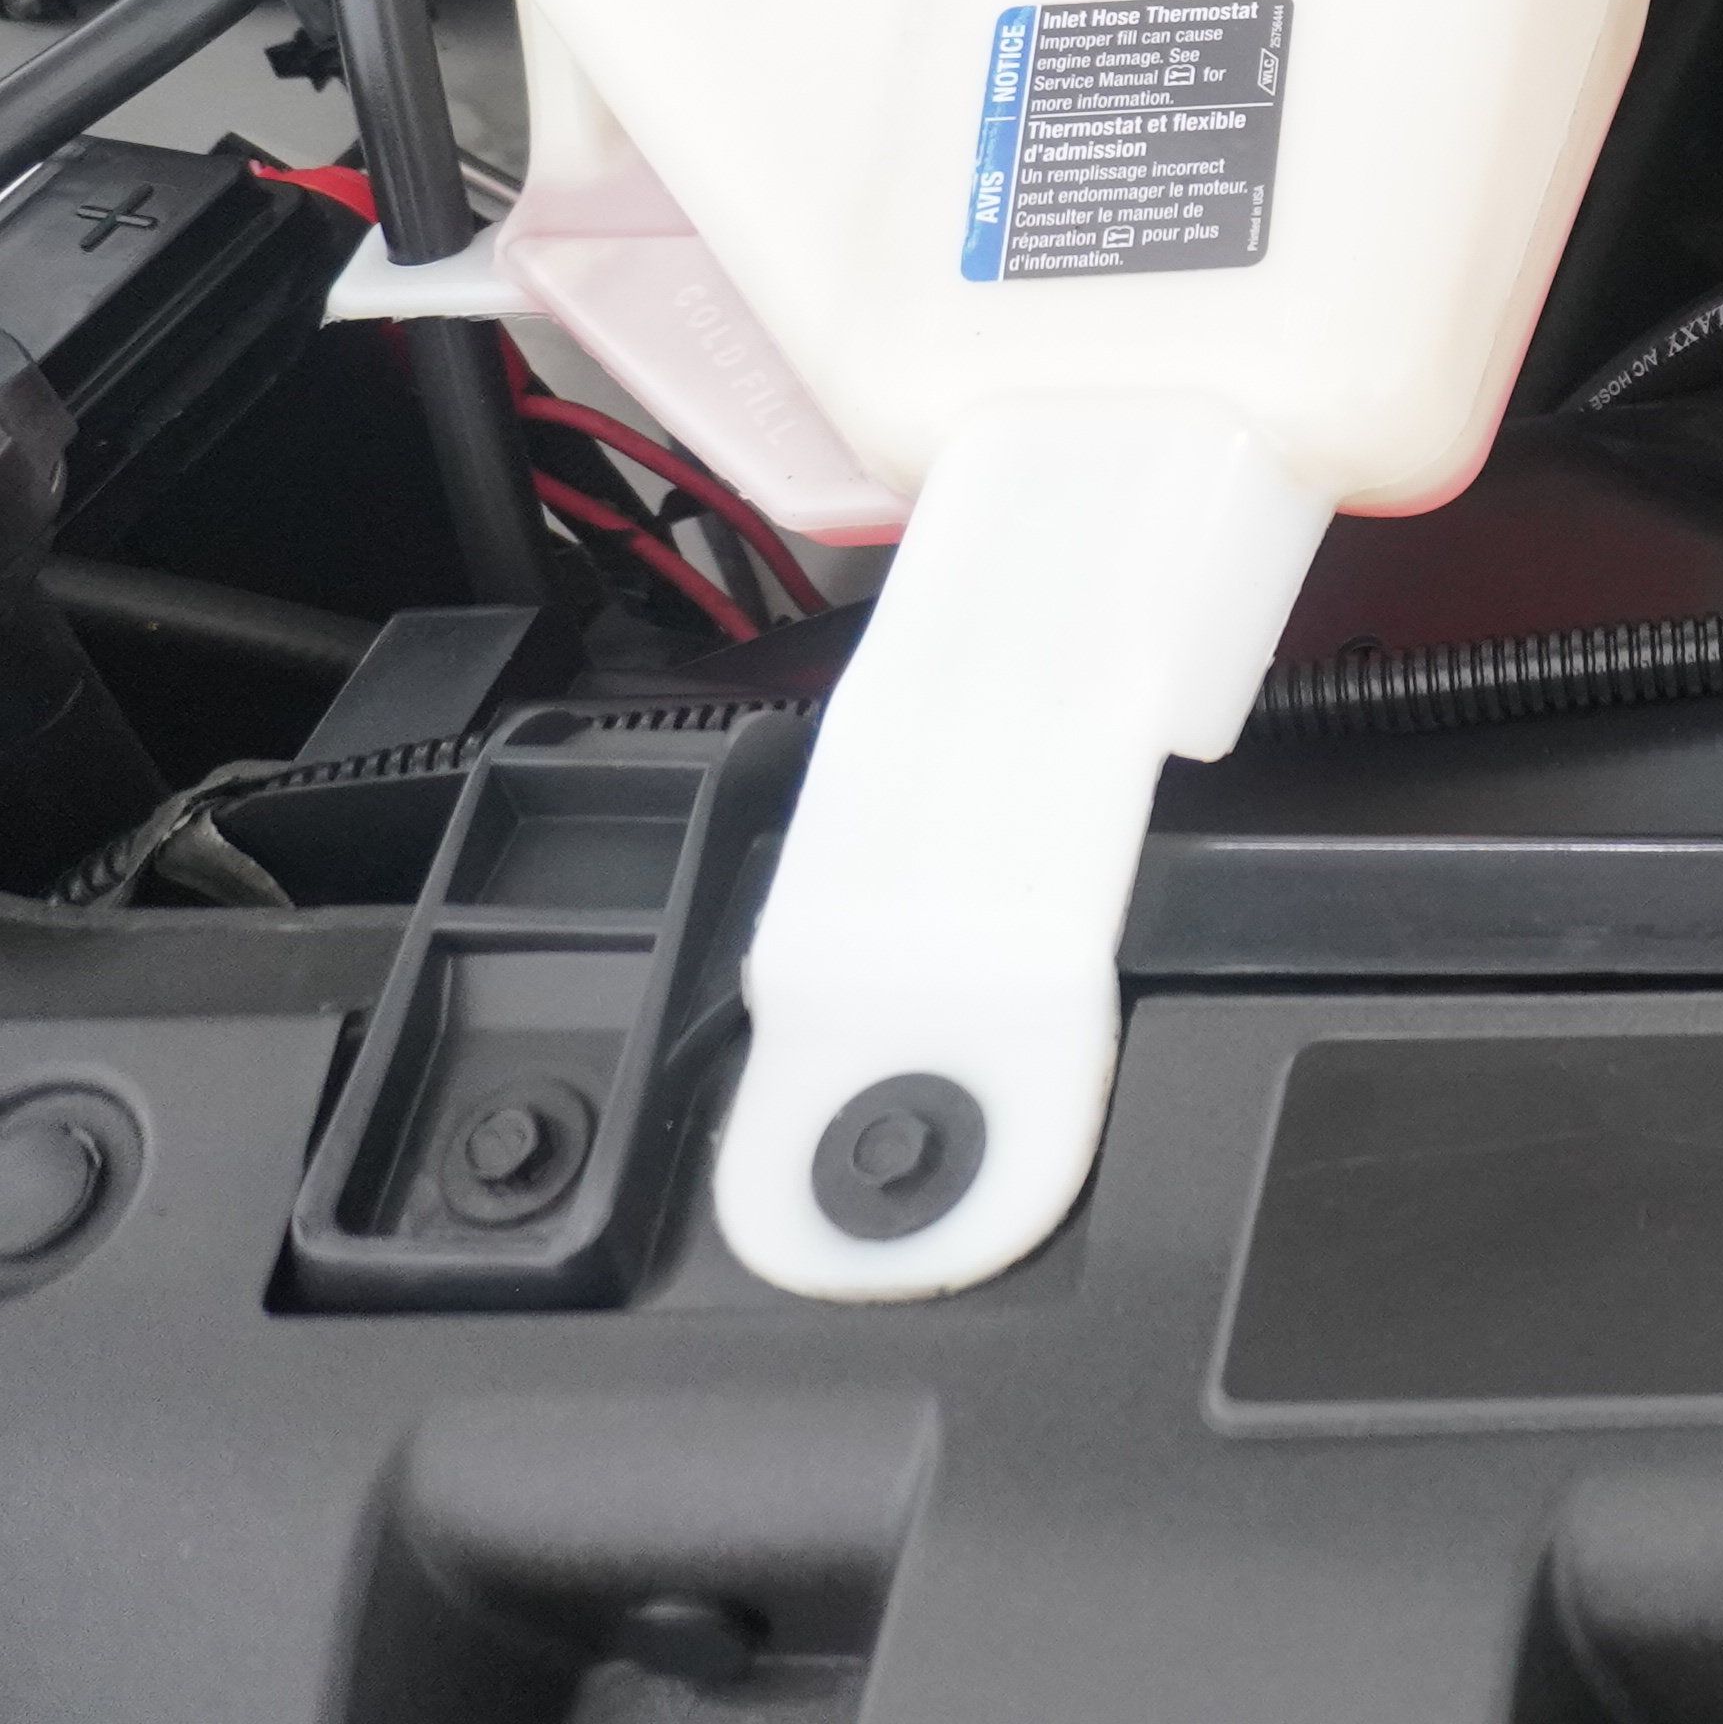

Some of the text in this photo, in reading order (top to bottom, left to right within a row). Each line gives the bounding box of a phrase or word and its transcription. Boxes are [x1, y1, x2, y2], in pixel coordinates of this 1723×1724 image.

[1042, 2, 1259, 29] Inlet Hose Thermostat
[1040, 28, 1223, 53] Improper fill can cause
[993, 25, 1026, 102] NOTICE
[1037, 48, 1200, 72] engine damage. See
[1262, 59, 1275, 85] WLC
[1034, 67, 1226, 91] Service Manual for
[1031, 91, 1174, 111] more information.
[1028, 112, 1246, 140] Thermostat et flexible
[1025, 140, 1147, 163] d'admission
[1021, 159, 1225, 184] Un remplissage incorrect
[975, 170, 1004, 223] AVIS
[1018, 181, 1248, 208] peut endommager le moteur.
[1253, 185, 1265, 205] USA
[1015, 203, 1203, 227] Consulter le manuel de
[1012, 224, 1219, 251] réparation pour plus
[1009, 253, 1124, 272] d'information.
[673, 284, 748, 367] COLD
[1589, 370, 1632, 410] HOSE
